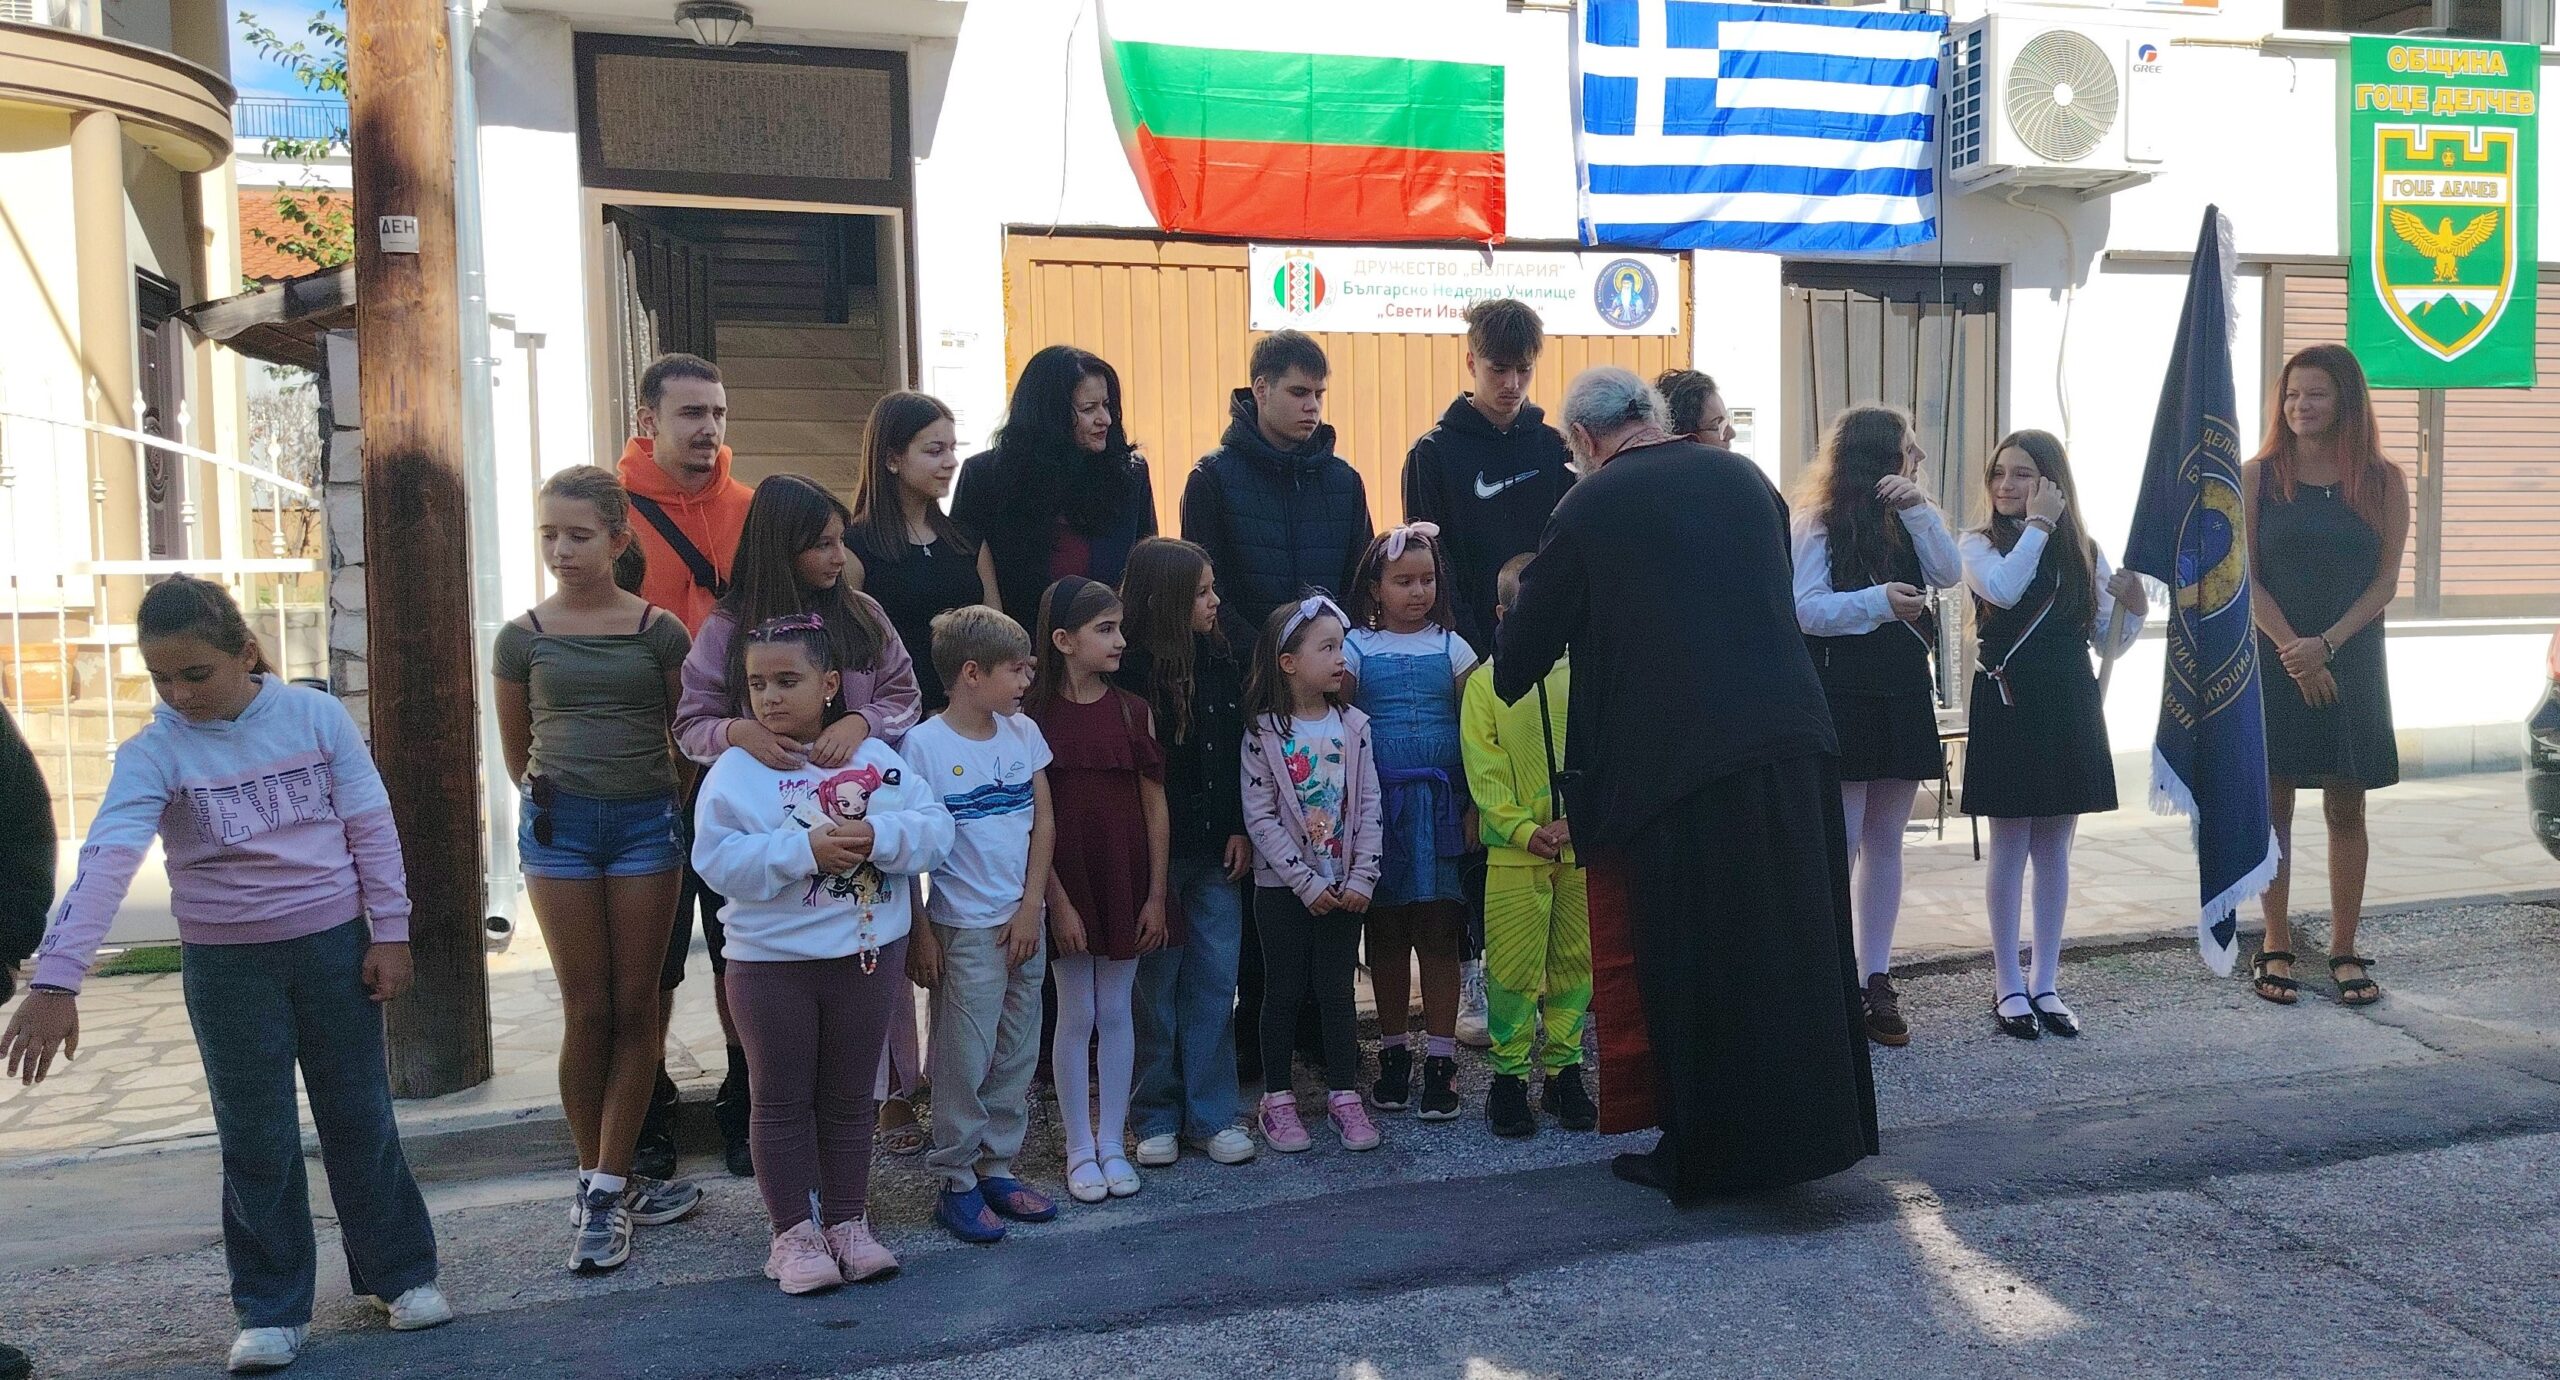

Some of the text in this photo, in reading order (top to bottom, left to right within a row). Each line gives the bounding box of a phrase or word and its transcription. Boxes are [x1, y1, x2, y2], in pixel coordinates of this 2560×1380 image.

[2133, 64, 2163, 73] GREE
[2388, 46, 2508, 77] ОБЩИНА
[2355, 84, 2535, 116] ГОЦЕ ДЕЛЧЕВ
[2392, 179, 2498, 198] ГОЦЕ ДЕЛЧЕВ
[1354, 259, 1457, 276] ДРУЖЕСТВО
[1344, 281, 1576, 300] Българско Неделно Училище
[1437, 304, 1466, 318] Ива
[2203, 428, 2241, 466] ДЕЛНО
